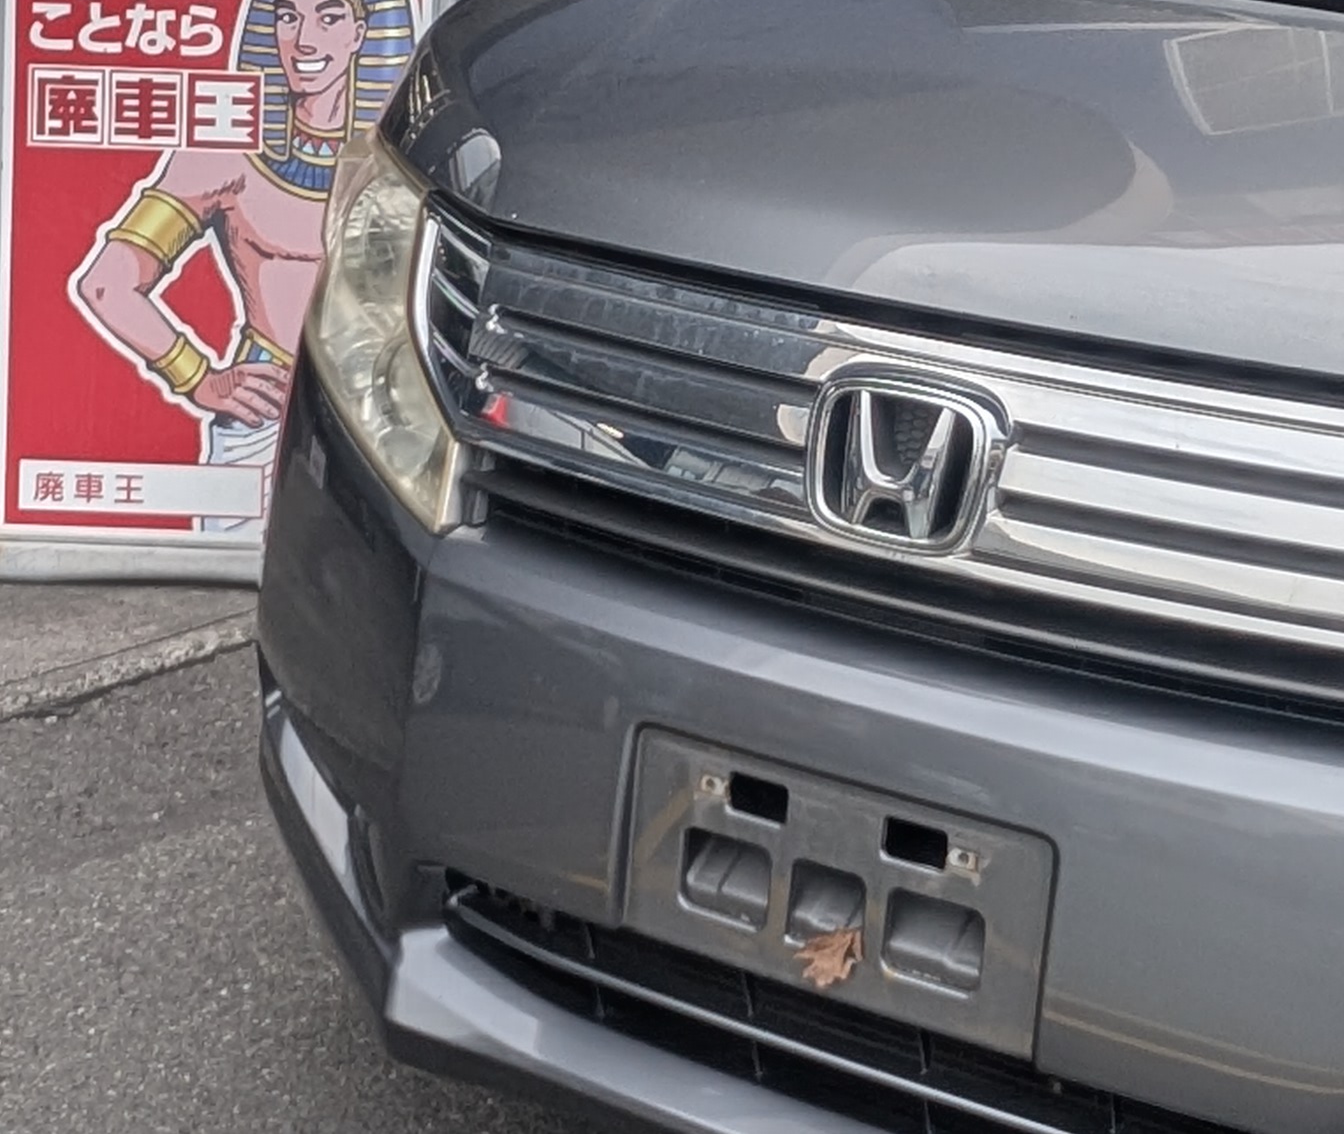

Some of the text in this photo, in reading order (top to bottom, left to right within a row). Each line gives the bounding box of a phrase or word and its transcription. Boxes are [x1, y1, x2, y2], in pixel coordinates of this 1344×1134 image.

[28, 1, 224, 57] ことなら
[33, 70, 259, 146] 廃車王
[33, 471, 145, 505] 廃車王
